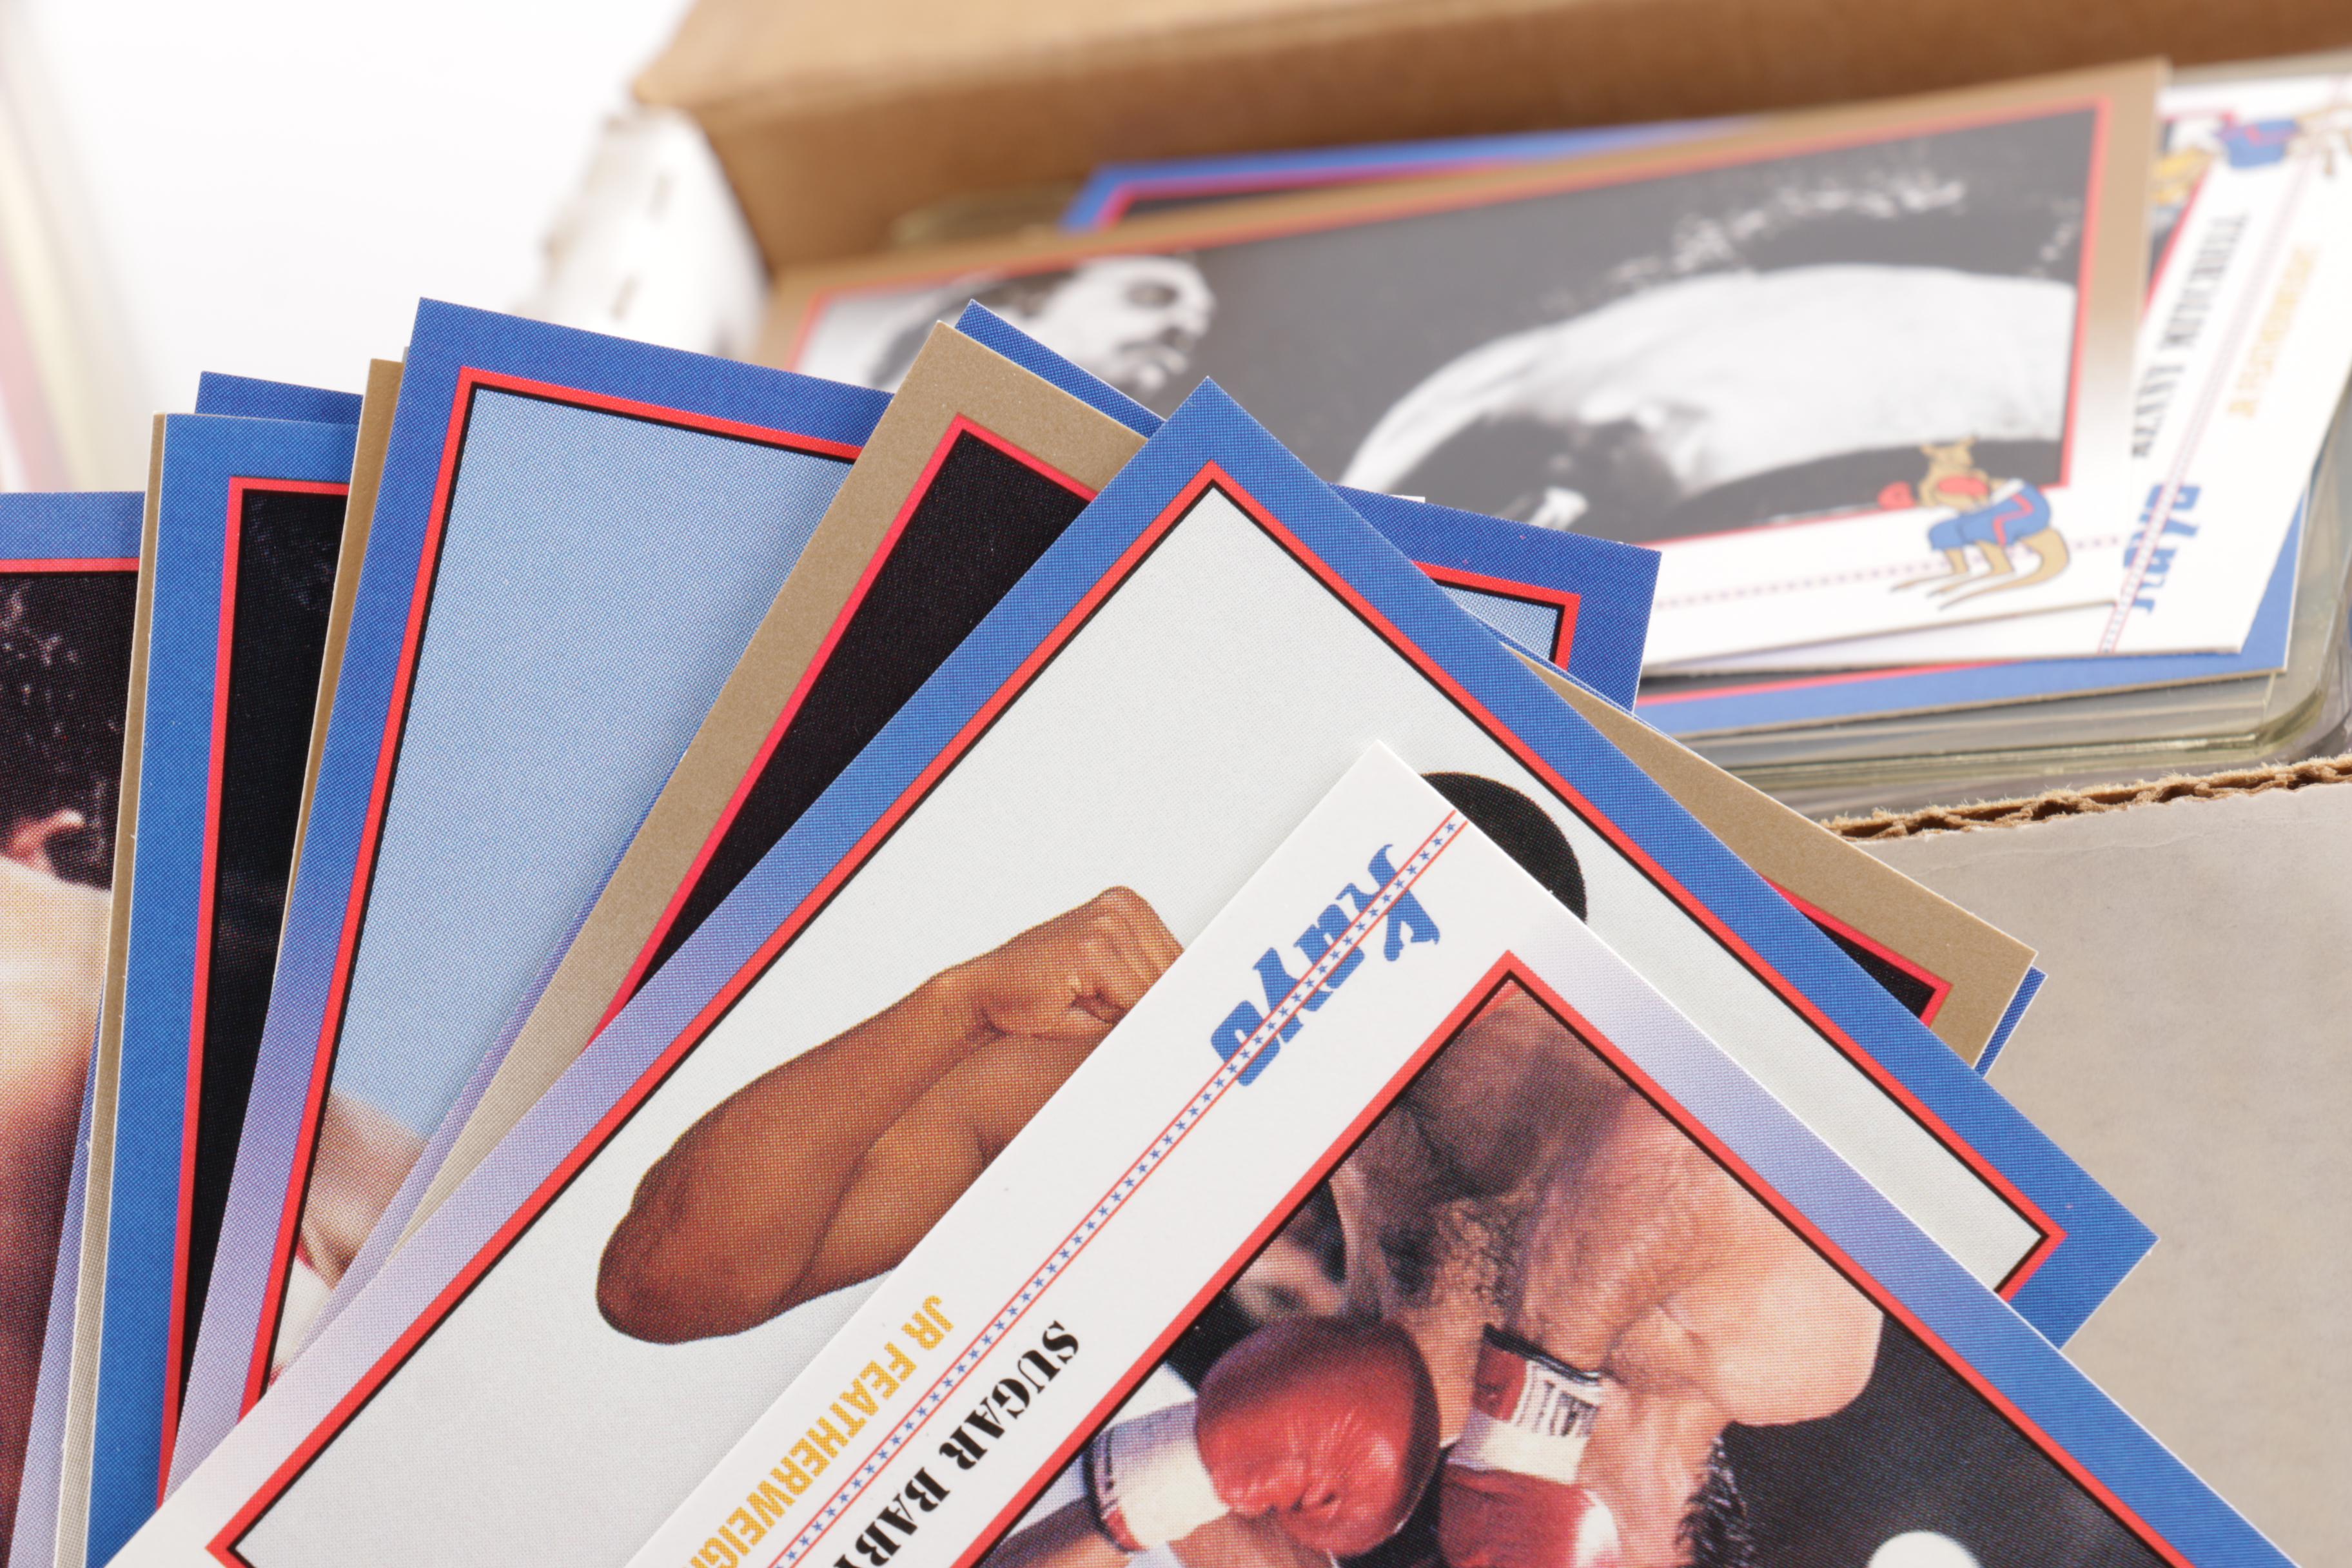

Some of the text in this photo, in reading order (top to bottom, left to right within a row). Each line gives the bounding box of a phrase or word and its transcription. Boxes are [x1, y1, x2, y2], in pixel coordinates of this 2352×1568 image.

[1211, 844, 1441, 1087] Kayo
[681, 1295, 954, 1568] JR FEATHERWEIG
[939, 1320, 1079, 1471] SUGAR
